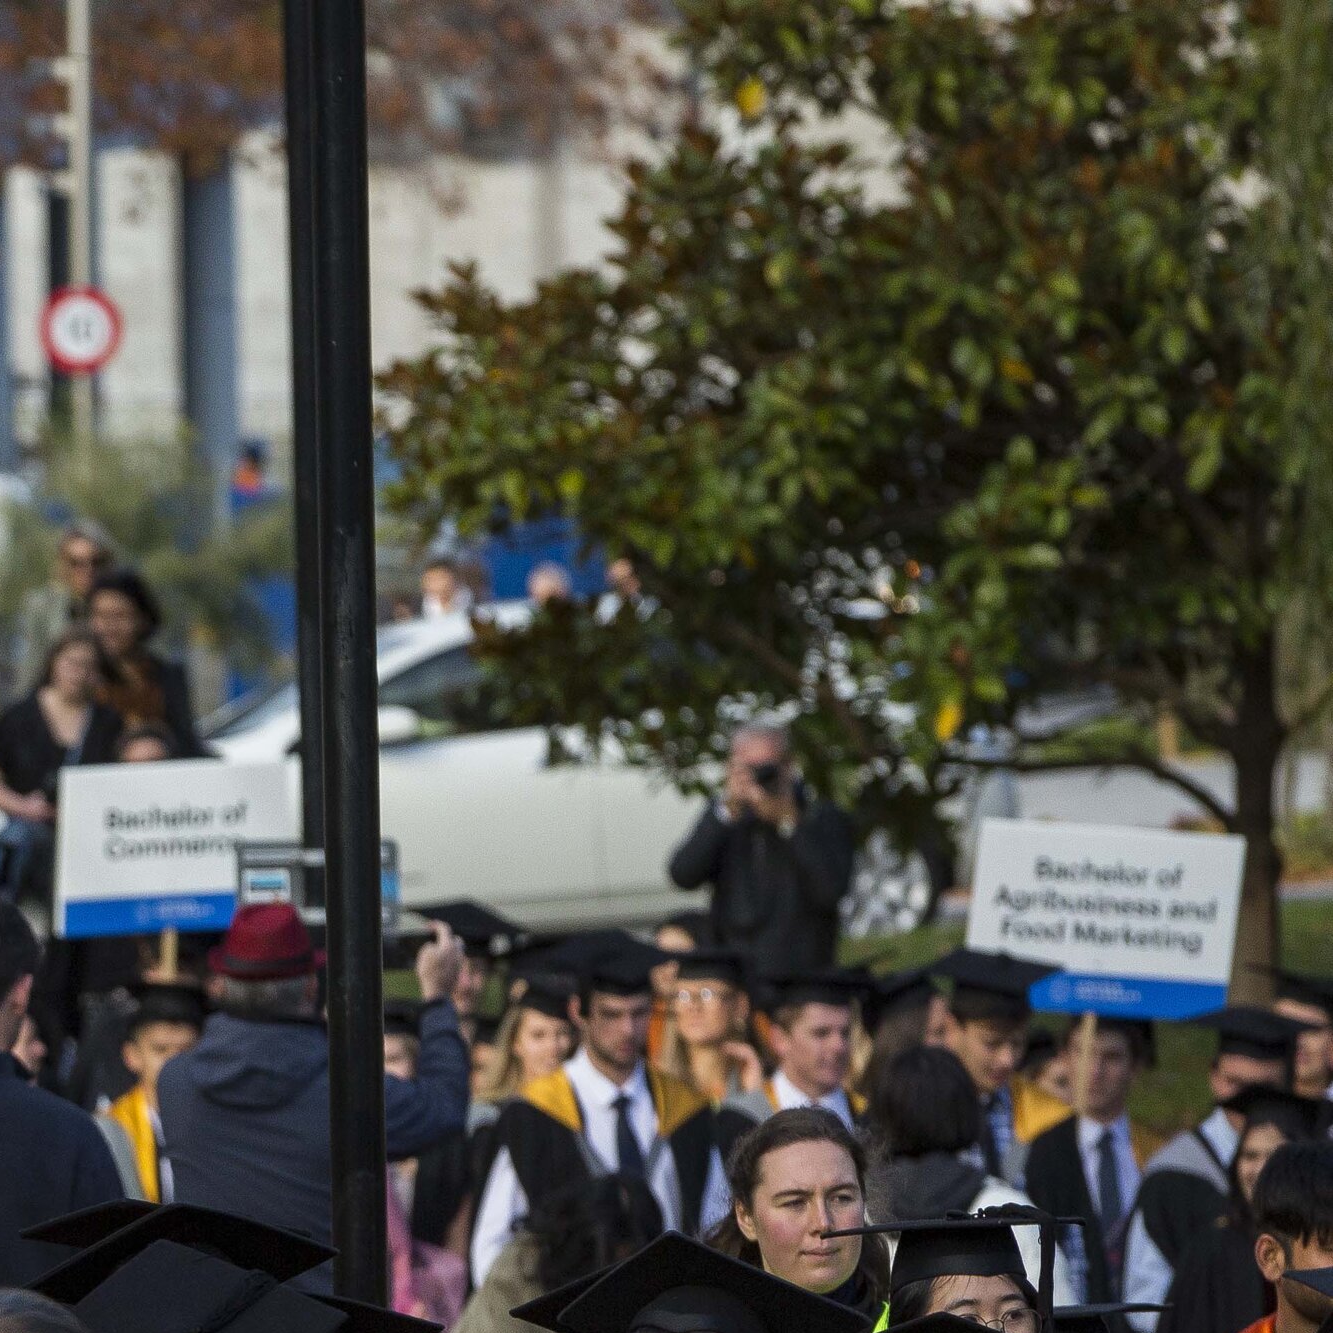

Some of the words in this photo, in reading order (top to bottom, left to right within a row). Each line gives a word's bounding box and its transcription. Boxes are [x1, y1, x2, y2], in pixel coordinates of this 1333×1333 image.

[105, 804, 214, 829] Bachelor
[220, 800, 248, 825] of
[1035, 856, 1149, 887] Bachelor
[1155, 861, 1184, 889] of
[996, 884, 1162, 915] Agribusiness
[1167, 897, 1219, 922] and
[1000, 913, 1066, 941] Food
[1073, 921, 1204, 956] Marketing
